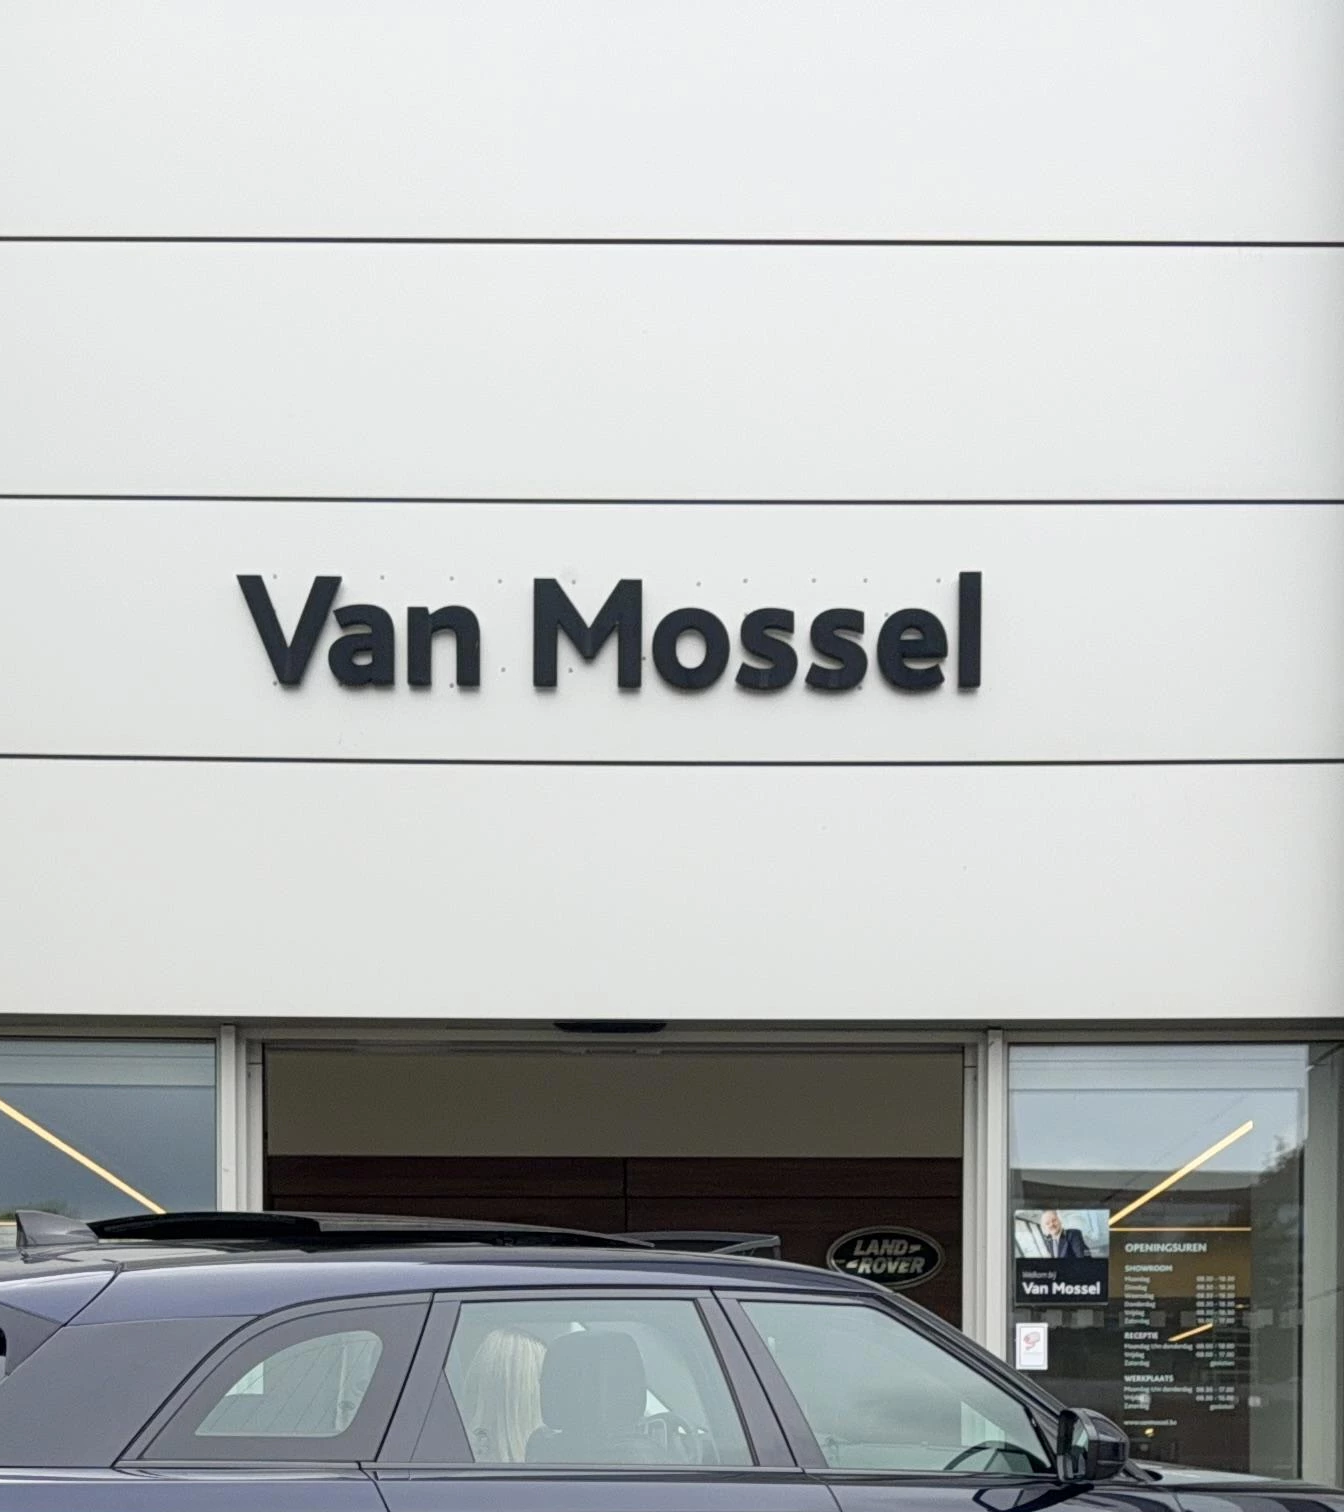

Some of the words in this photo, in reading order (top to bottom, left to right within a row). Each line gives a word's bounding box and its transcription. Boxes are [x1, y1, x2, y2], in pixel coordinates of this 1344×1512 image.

[237, 573, 481, 688] Van
[533, 571, 983, 692] Mossel
[854, 1239, 908, 1256] LAND
[1124, 1243, 1207, 1253] OPENINGSUREN
[857, 1256, 926, 1274] ROVER
[1124, 1264, 1173, 1272] SHOWROOM
[1022, 1281, 1049, 1295] Van
[1052, 1281, 1101, 1295] Mossel
[1124, 1375, 1174, 1383] WERKPLAATS
